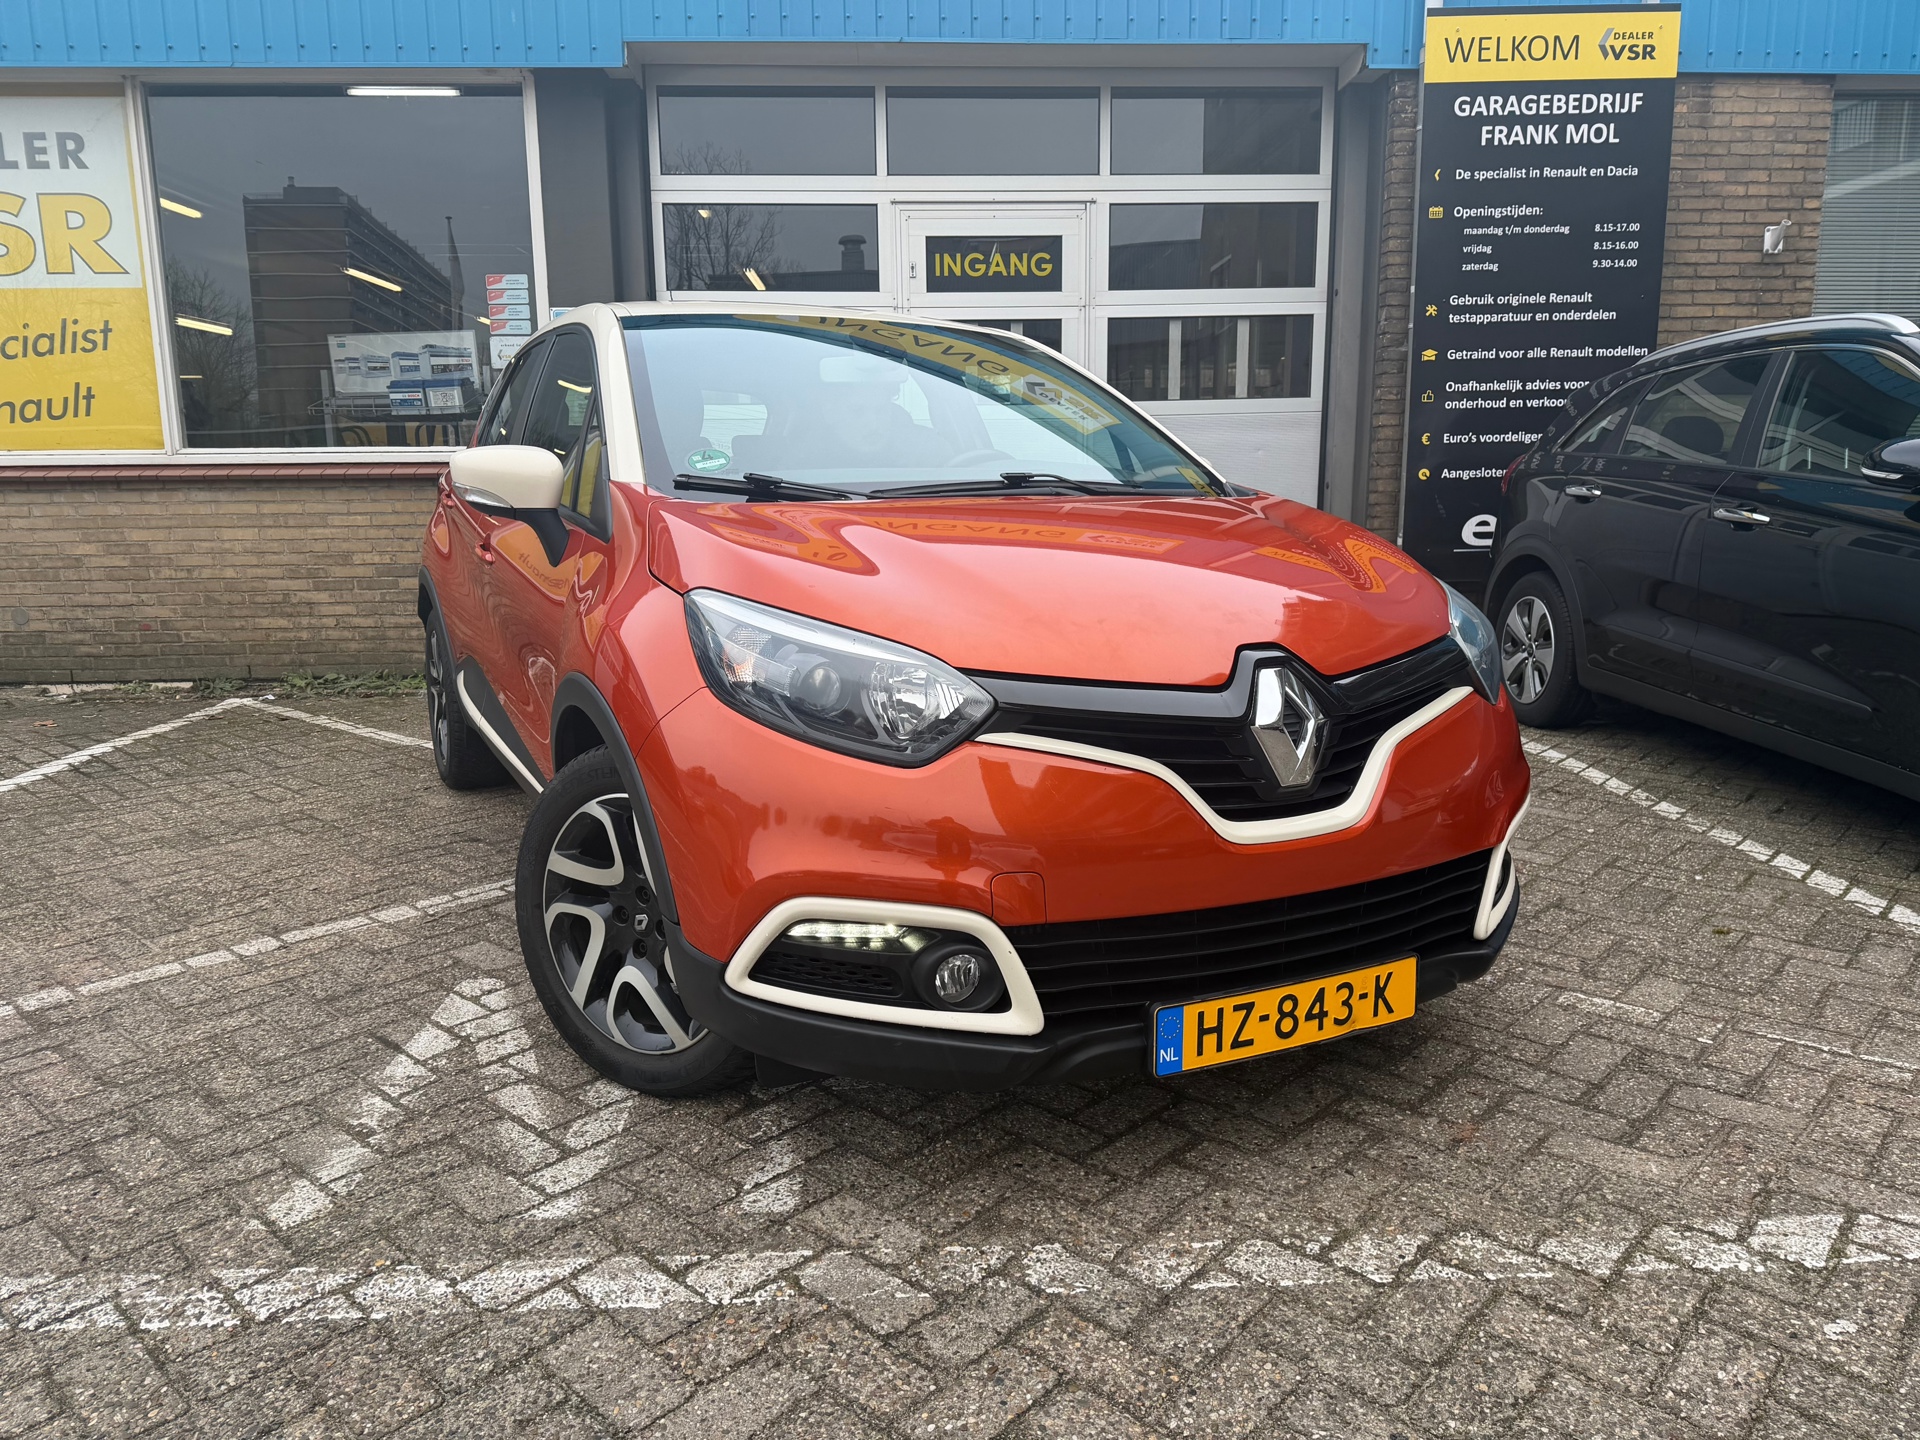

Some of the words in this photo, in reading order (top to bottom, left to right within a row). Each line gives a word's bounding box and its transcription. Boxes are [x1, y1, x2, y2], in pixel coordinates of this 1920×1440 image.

[1613, 31, 1655, 41] DEALER
[1444, 35, 1580, 63] WELKOM
[1609, 43, 1657, 61] VSR
[1453, 92, 1644, 117] GARAGEBEDRIJF
[1481, 124, 1559, 146] FRANK
[1565, 122, 1620, 144] MOL
[1455, 169, 1471, 180] De
[1473, 167, 1527, 182] specialist
[1529, 166, 1540, 178] in
[1543, 165, 1588, 178] Renault
[1589, 168, 1604, 177] en
[1607, 164, 1639, 177] Dacia
[1453, 204, 1544, 220] Openingstijden:
[1463, 225, 1504, 236] maandag
[1504, 224, 1522, 236] t/m
[1523, 224, 1570, 235] donderdag
[1594, 222, 1641, 232] 8.15-17.00
[1462, 243, 1493, 255] vrijdag
[1593, 240, 1639, 250] 8.15-16.00
[935, 253, 1053, 277] INGANG
[1461, 261, 1499, 272] zaterdag
[1592, 258, 1638, 268] 9.30-14.00
[1449, 293, 1495, 306] Gebruik
[1496, 292, 1547, 307] originele
[1549, 291, 1593, 304] Renault
[1448, 312, 1534, 325] testapparatuur
[1535, 312, 1549, 322] en
[1552, 309, 1617, 321] onderdelen
[1447, 347, 1496, 360] Getraind
[1499, 350, 1525, 359] voor
[1526, 346, 1548, 359] alle
[1550, 346, 1594, 358] Renault
[1595, 345, 1649, 358] modellen
[1445, 379, 1523, 393] Onafhankelijk
[1525, 379, 1562, 391] advies
[1444, 397, 1507, 410] onderhoud
[1509, 399, 1524, 408] en
[1526, 396, 1568, 408] verkoo
[1196, 971, 1395, 1057] HZ-843-K
[1159, 1046, 1179, 1064] NL
